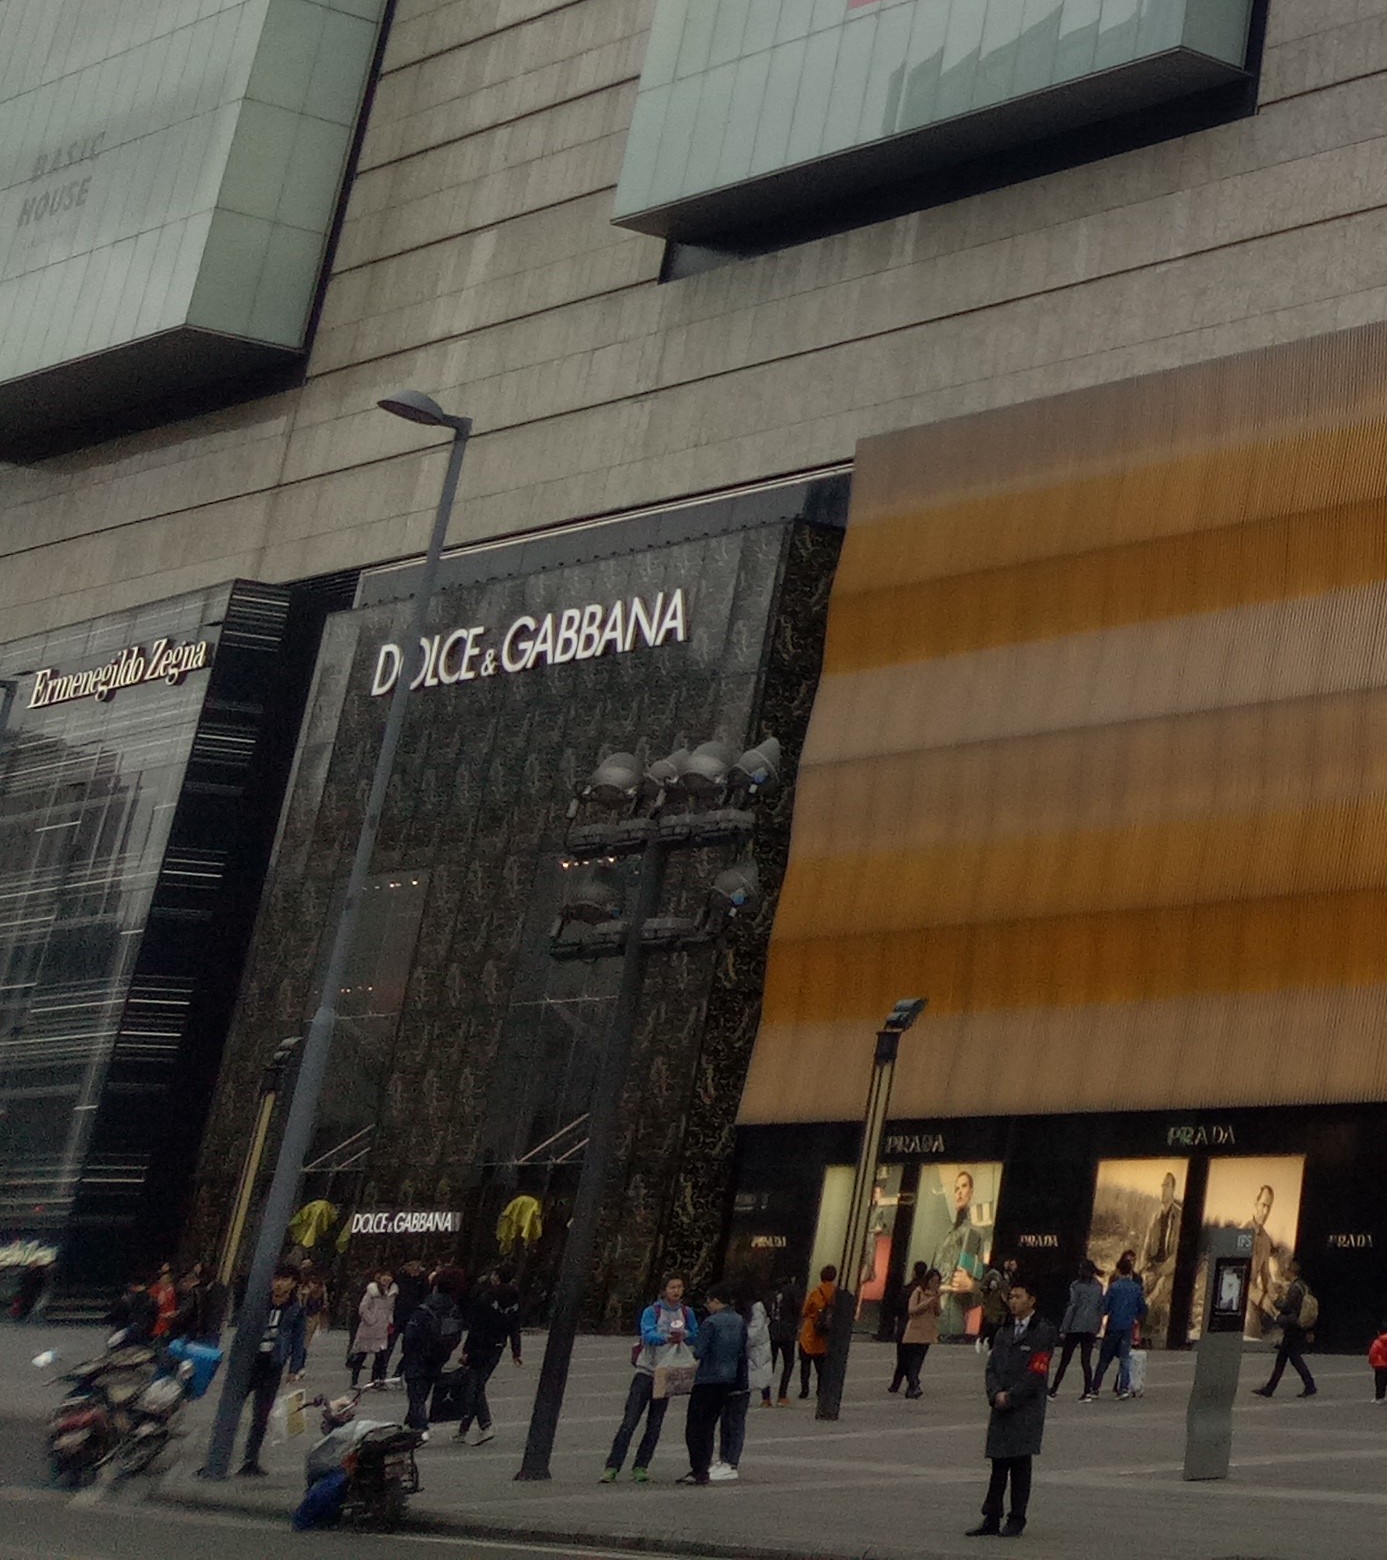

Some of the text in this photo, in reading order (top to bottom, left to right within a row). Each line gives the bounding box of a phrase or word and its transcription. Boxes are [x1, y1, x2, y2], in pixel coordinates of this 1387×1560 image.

[17, 175, 93, 228] HOUSE
[502, 588, 686, 673] GABBANA
[27, 637, 207, 710] Ermenegildo Zegna
[884, 1134, 946, 1154] PRADA
[1167, 1124, 1236, 1147] PRADA
